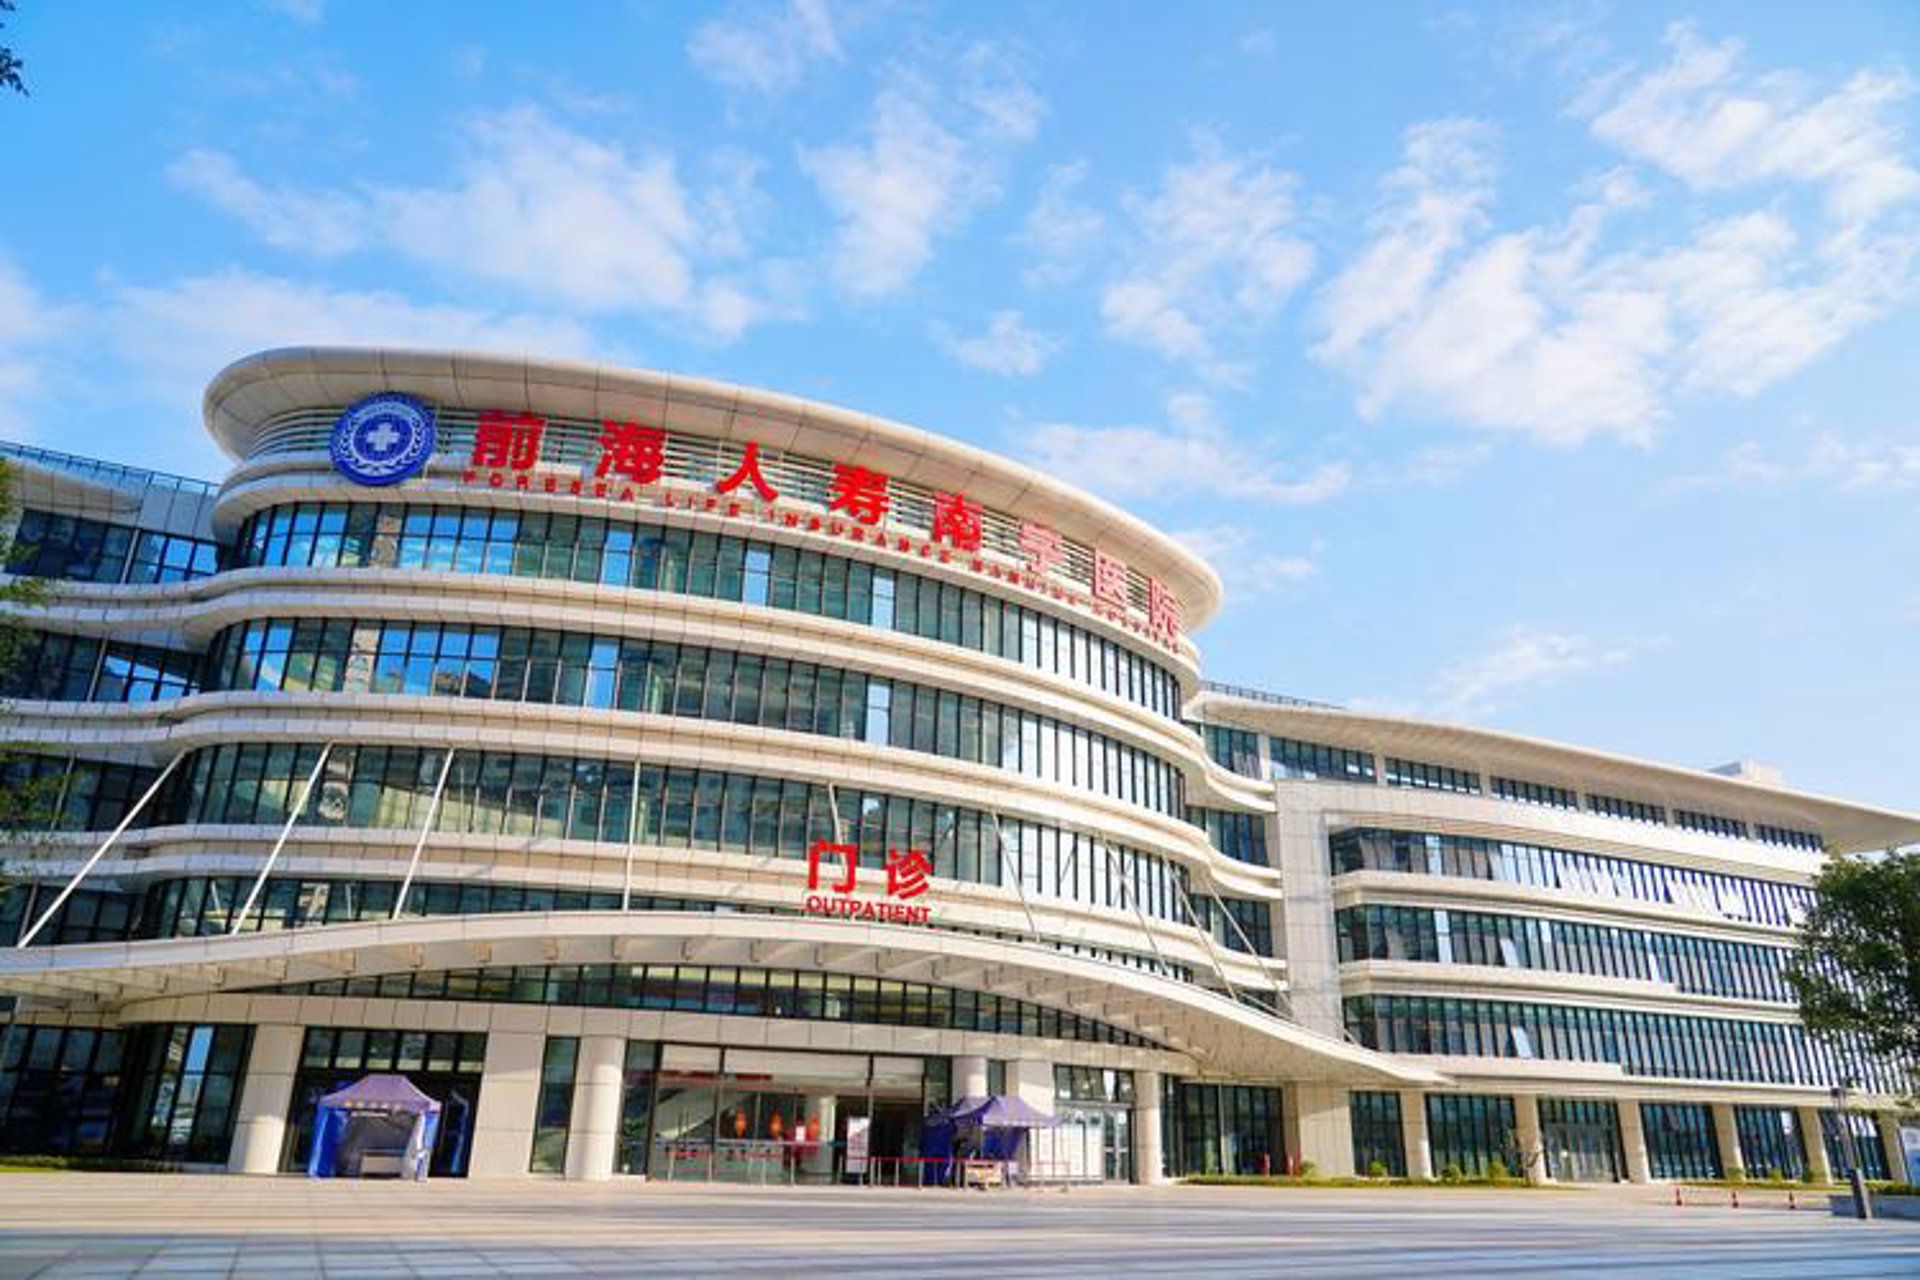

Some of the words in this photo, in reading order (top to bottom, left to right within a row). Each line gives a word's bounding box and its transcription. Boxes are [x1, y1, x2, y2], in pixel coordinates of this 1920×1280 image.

[472, 409, 1180, 637] 前海人寿南宁医院
[808, 839, 932, 899] 门诊
[806, 895, 932, 922] OUTPATIENT
